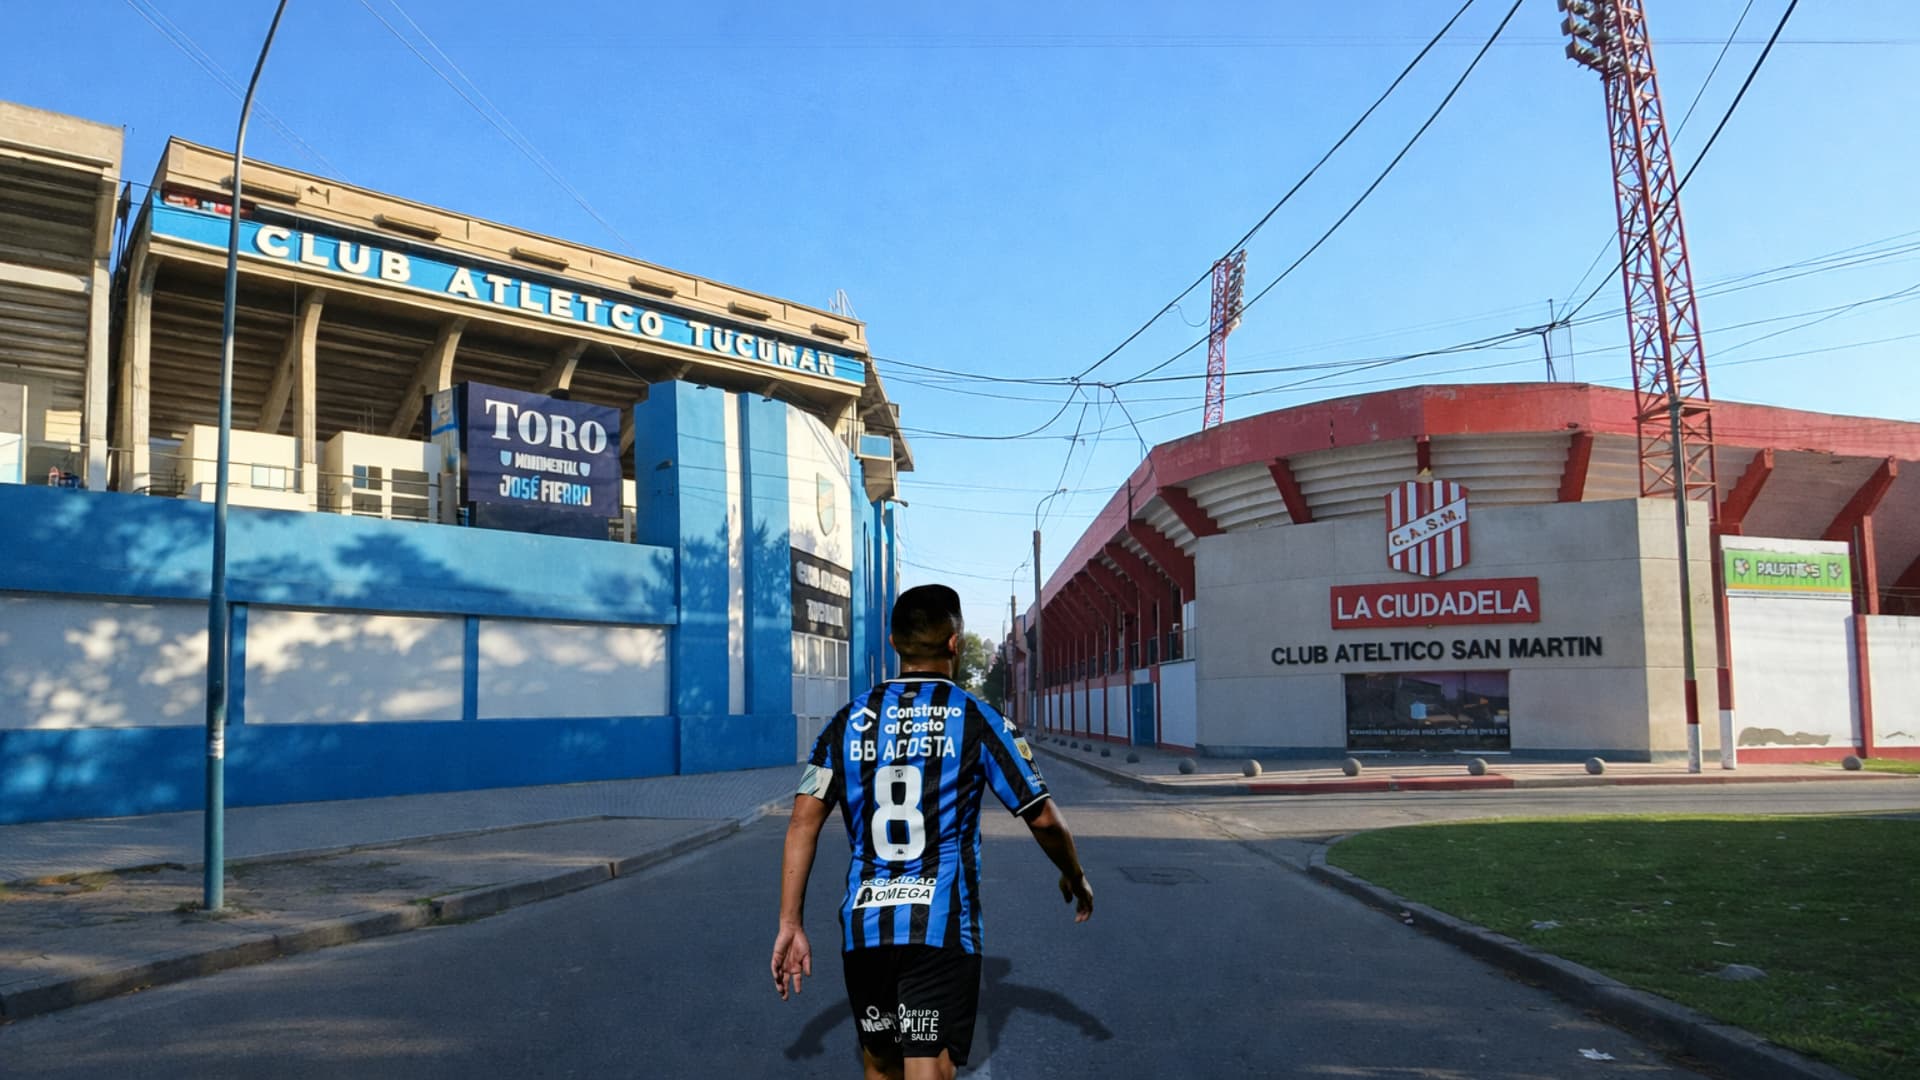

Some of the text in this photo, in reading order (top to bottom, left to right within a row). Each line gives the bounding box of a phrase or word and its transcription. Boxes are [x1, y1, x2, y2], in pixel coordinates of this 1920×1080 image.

[256, 225, 411, 283] CLUB
[448, 266, 664, 338] ATLETCO
[485, 399, 607, 454] TORO
[499, 474, 592, 506] JOSÉ FIERRO
[1337, 589, 1532, 621] LA CIUDADELA
[1271, 636, 1603, 665] CLUB ATELTICO SAN MARTIN
[886, 704, 962, 719] Construyo
[884, 719, 944, 734] al Costo
[850, 736, 956, 761] BB ACOSTA
[871, 765, 926, 861] 8
[875, 887, 931, 902] OMEGA
[906, 1009, 940, 1018] GRUPO
[911, 1033, 938, 1041] SALUD
